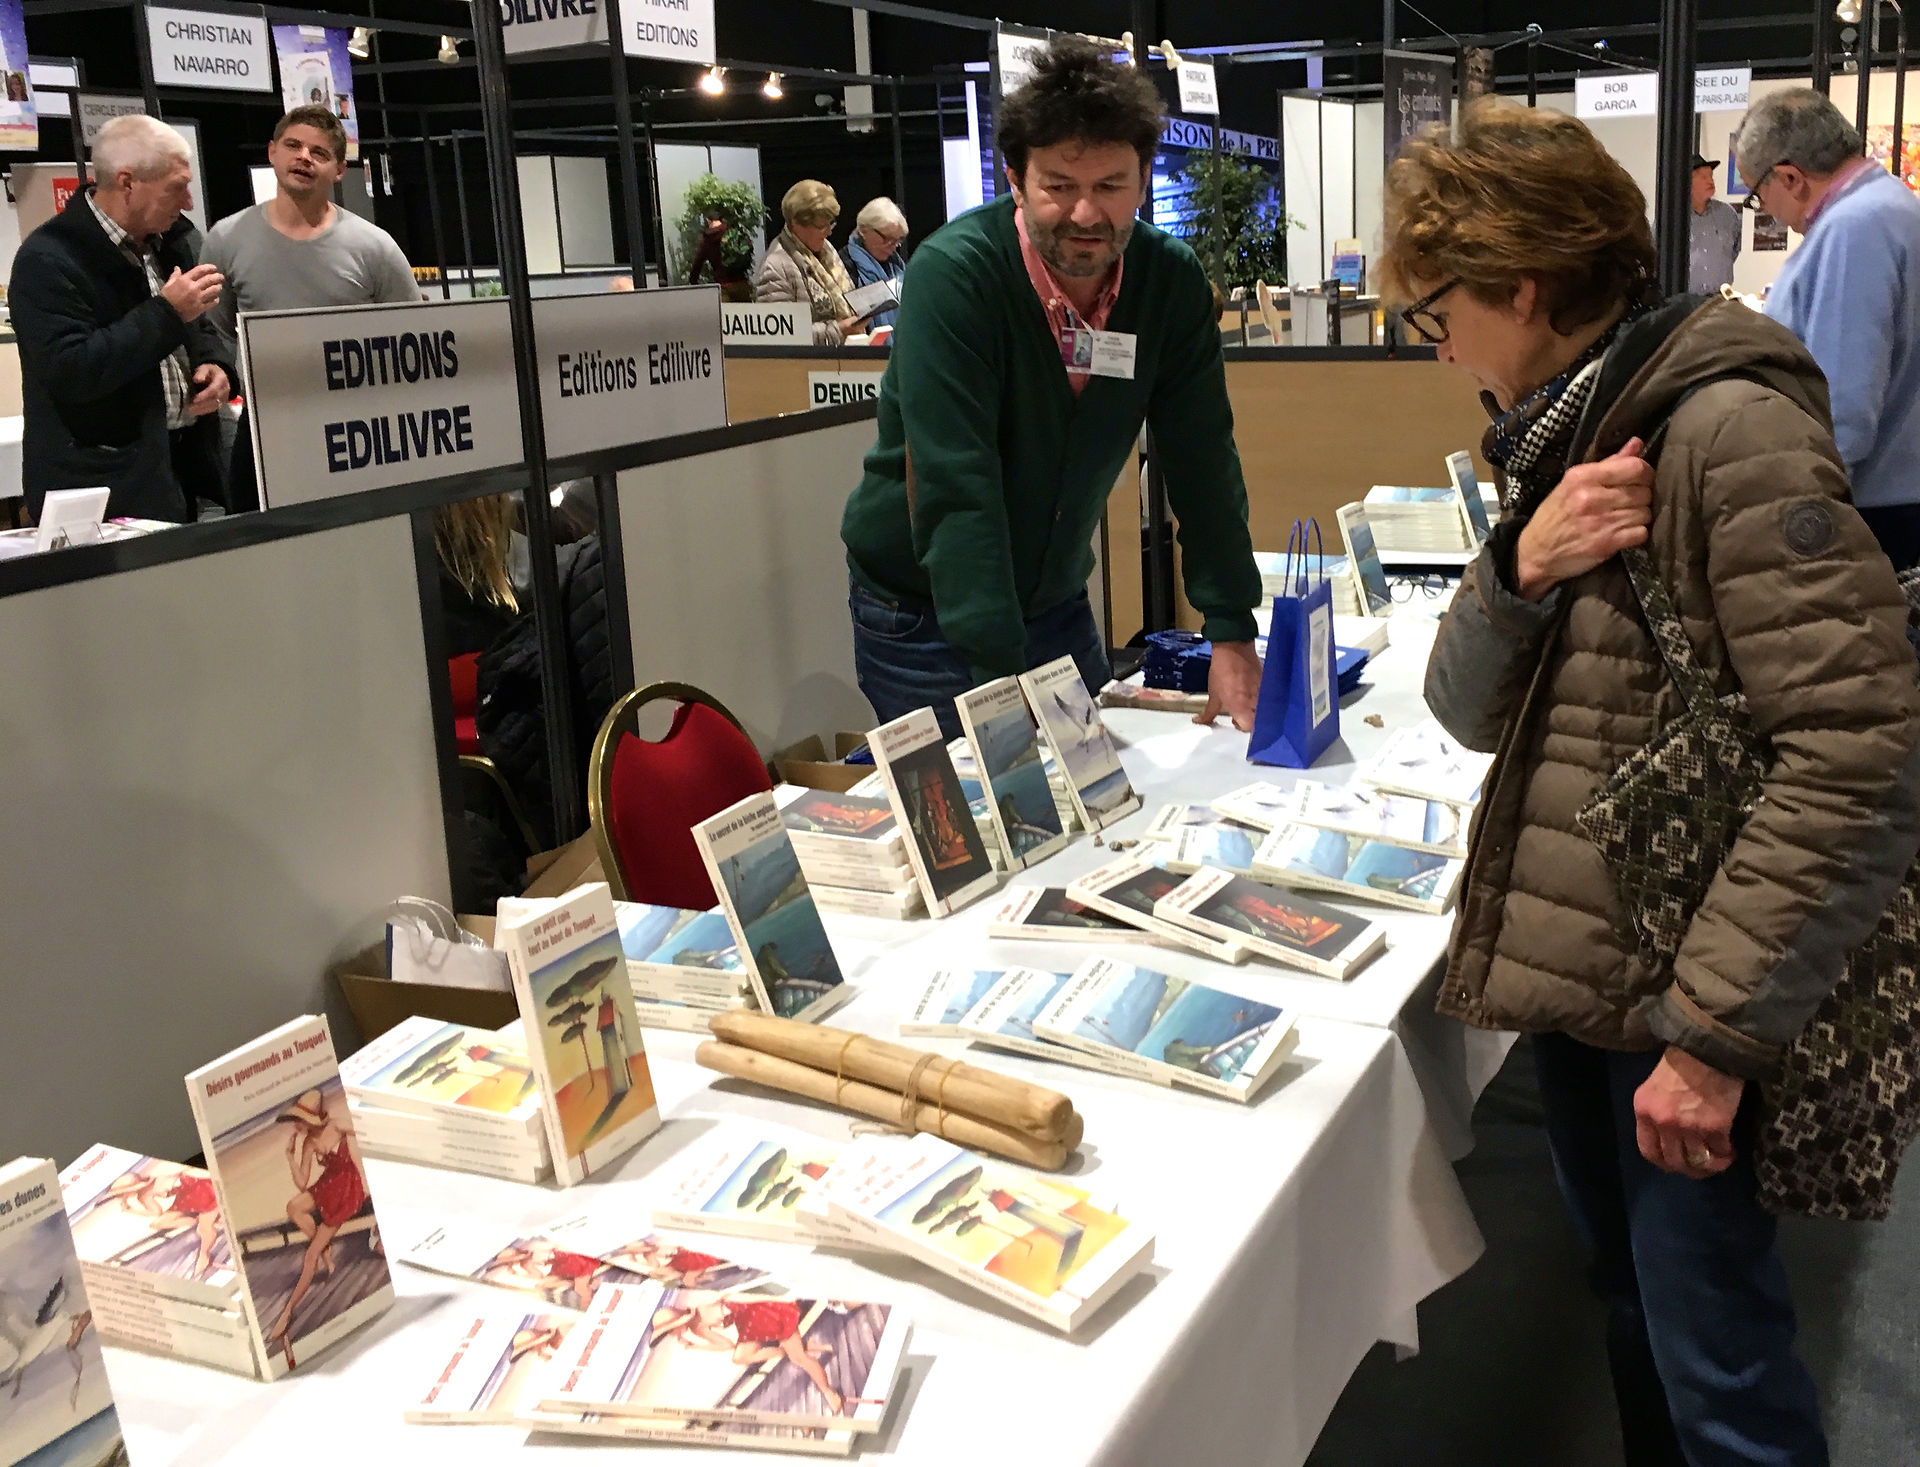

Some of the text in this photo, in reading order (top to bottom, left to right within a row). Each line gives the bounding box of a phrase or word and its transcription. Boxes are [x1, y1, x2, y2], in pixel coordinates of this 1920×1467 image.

[165, 21, 253, 45] CHRISTIAN
[636, 21, 698, 48] EDITIONS
[173, 54, 250, 76] NAVARRO
[1604, 82, 1629, 94] BOB
[1721, 75, 1738, 86] DU
[1594, 100, 1637, 111] GARCIA
[1220, 131, 1235, 151] de
[1240, 134, 1252, 154] la
[722, 313, 794, 336] JAILLON
[323, 330, 458, 390] EDITIONS
[558, 340, 712, 399] Editions Edilivre
[813, 382, 879, 404] DENIS
[324, 405, 474, 473] EDILIVRE
[205, 1075, 234, 1098] Désirs
[234, 1052, 281, 1085] gourmands
[282, 1047, 293, 1060] au
[293, 1029, 327, 1054] Touquet
[15, 1183, 46, 1208] dunes
